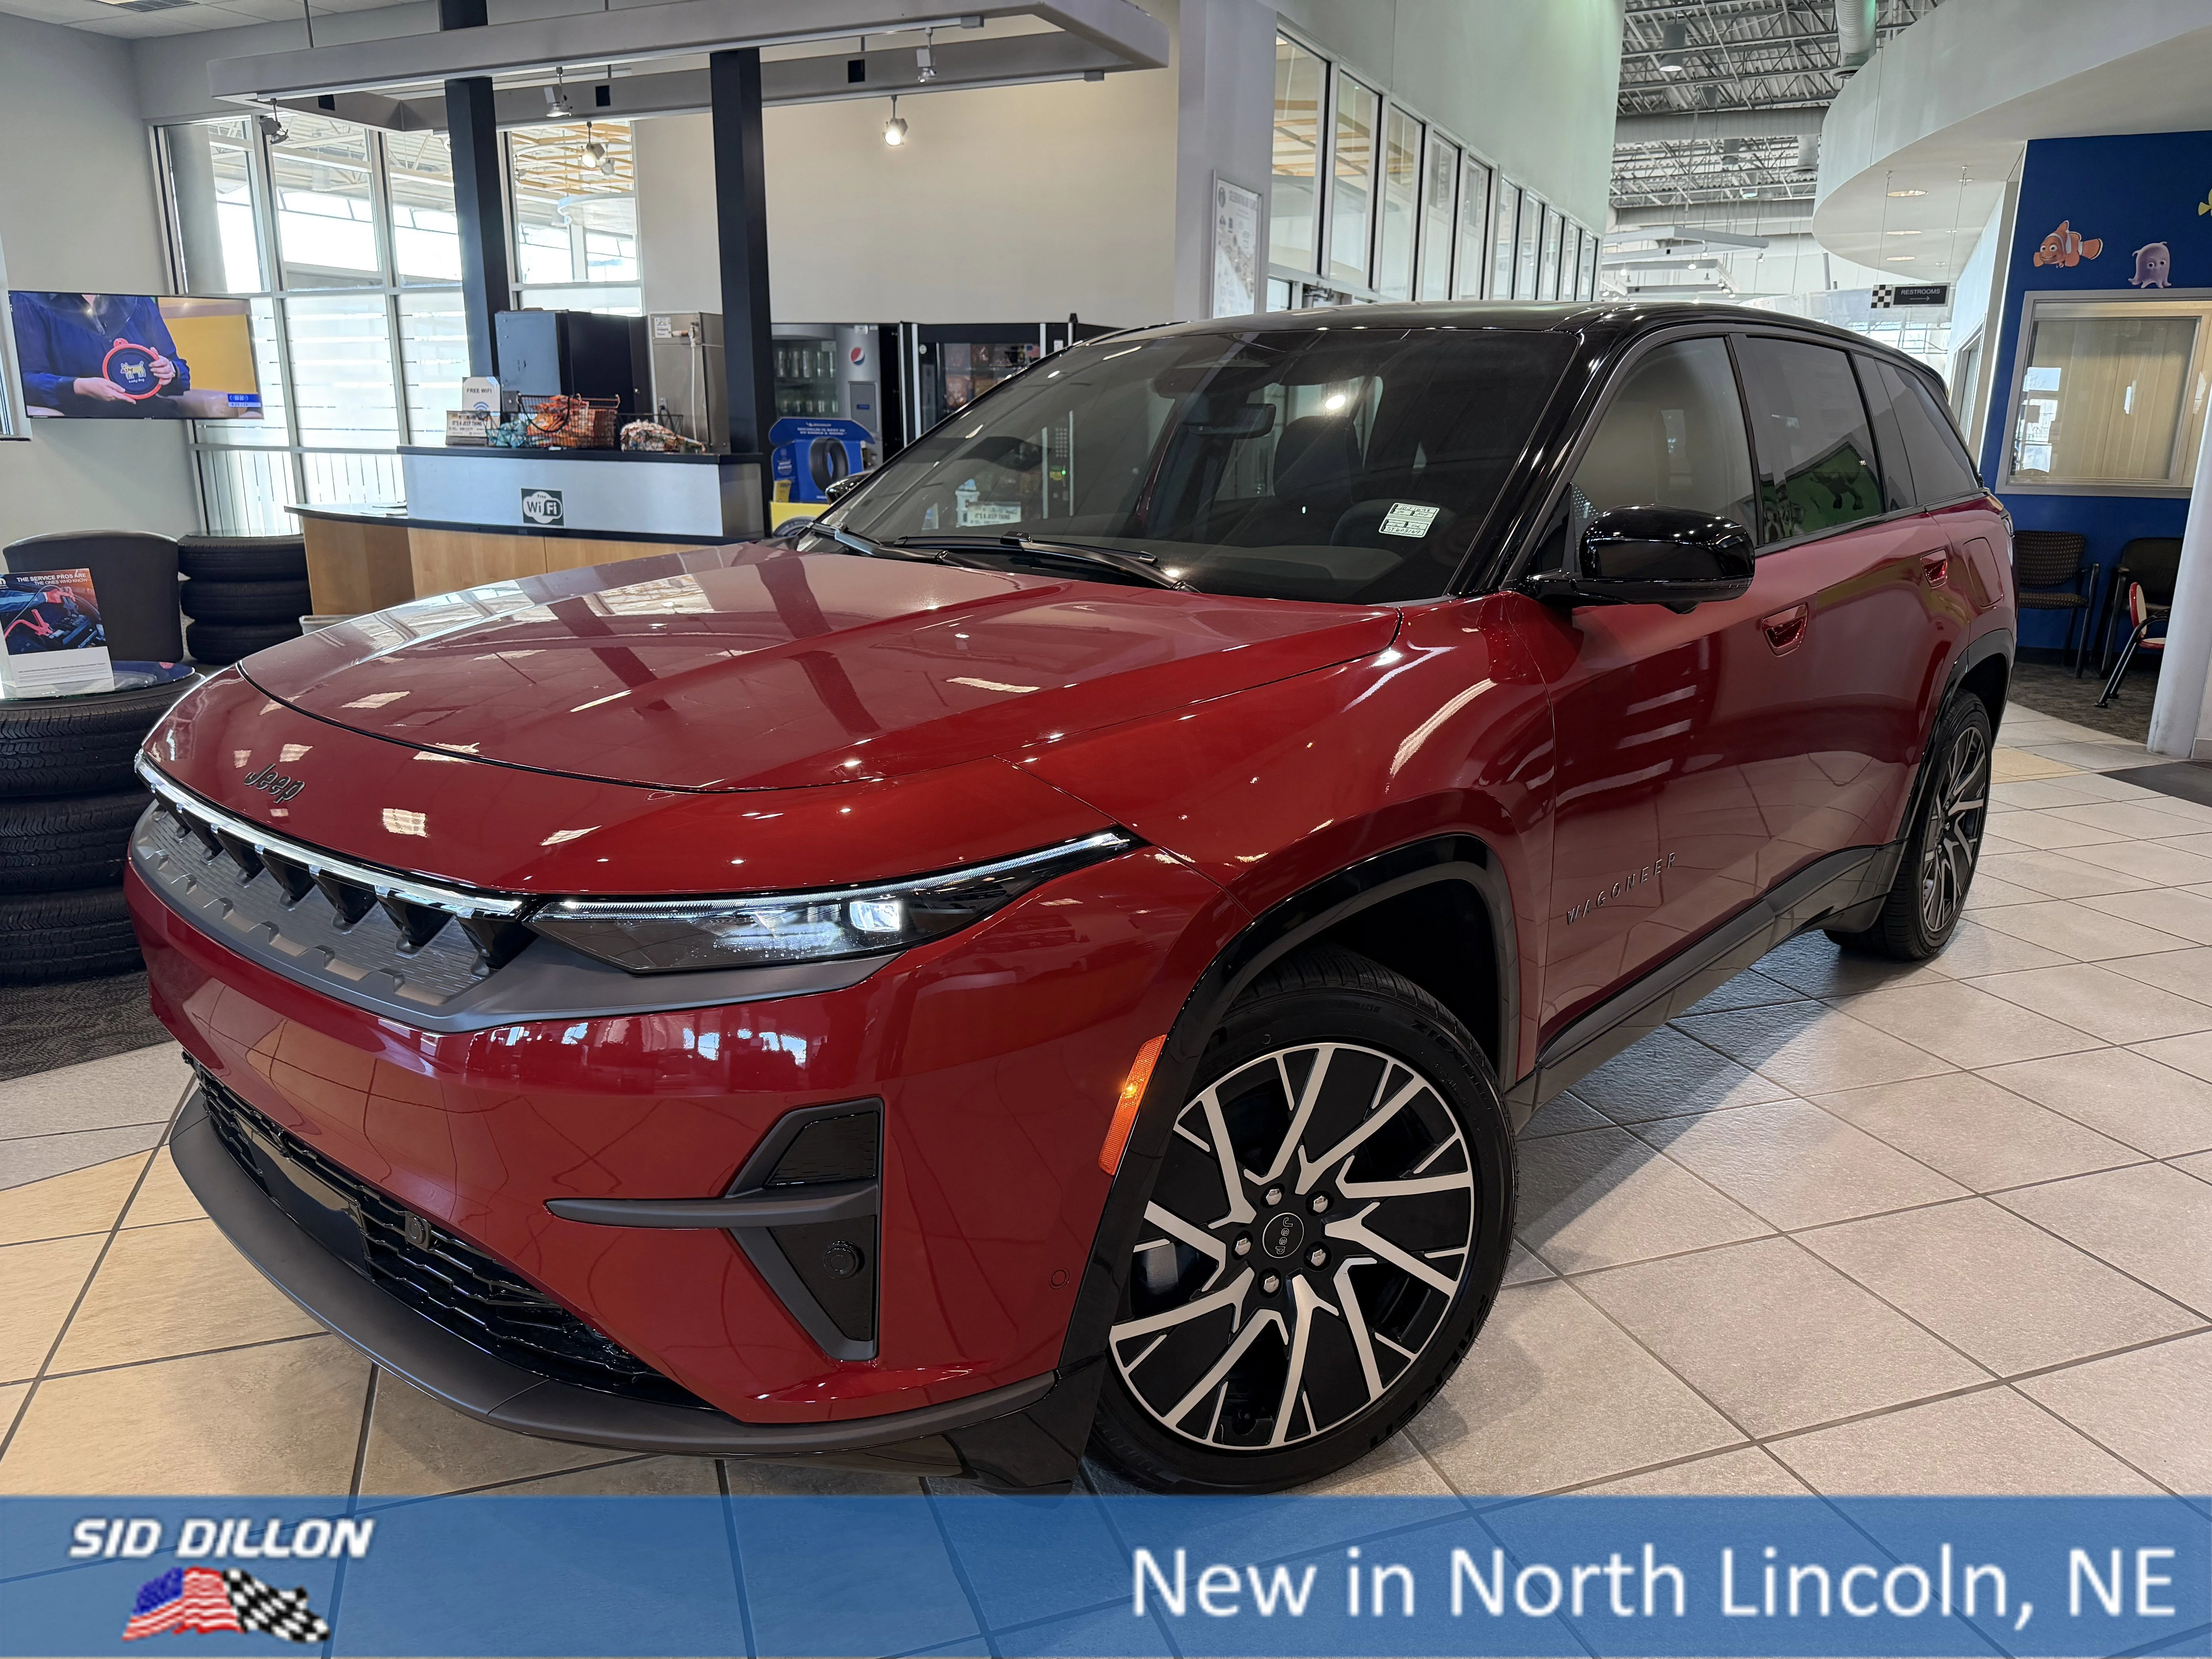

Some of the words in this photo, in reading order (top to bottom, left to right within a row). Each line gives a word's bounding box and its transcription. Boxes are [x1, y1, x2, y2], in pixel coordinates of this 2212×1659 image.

[244, 763, 306, 804] Jeep
[1566, 852, 1676, 926] WAGONEER
[1275, 1217, 1293, 1255] Jeep
